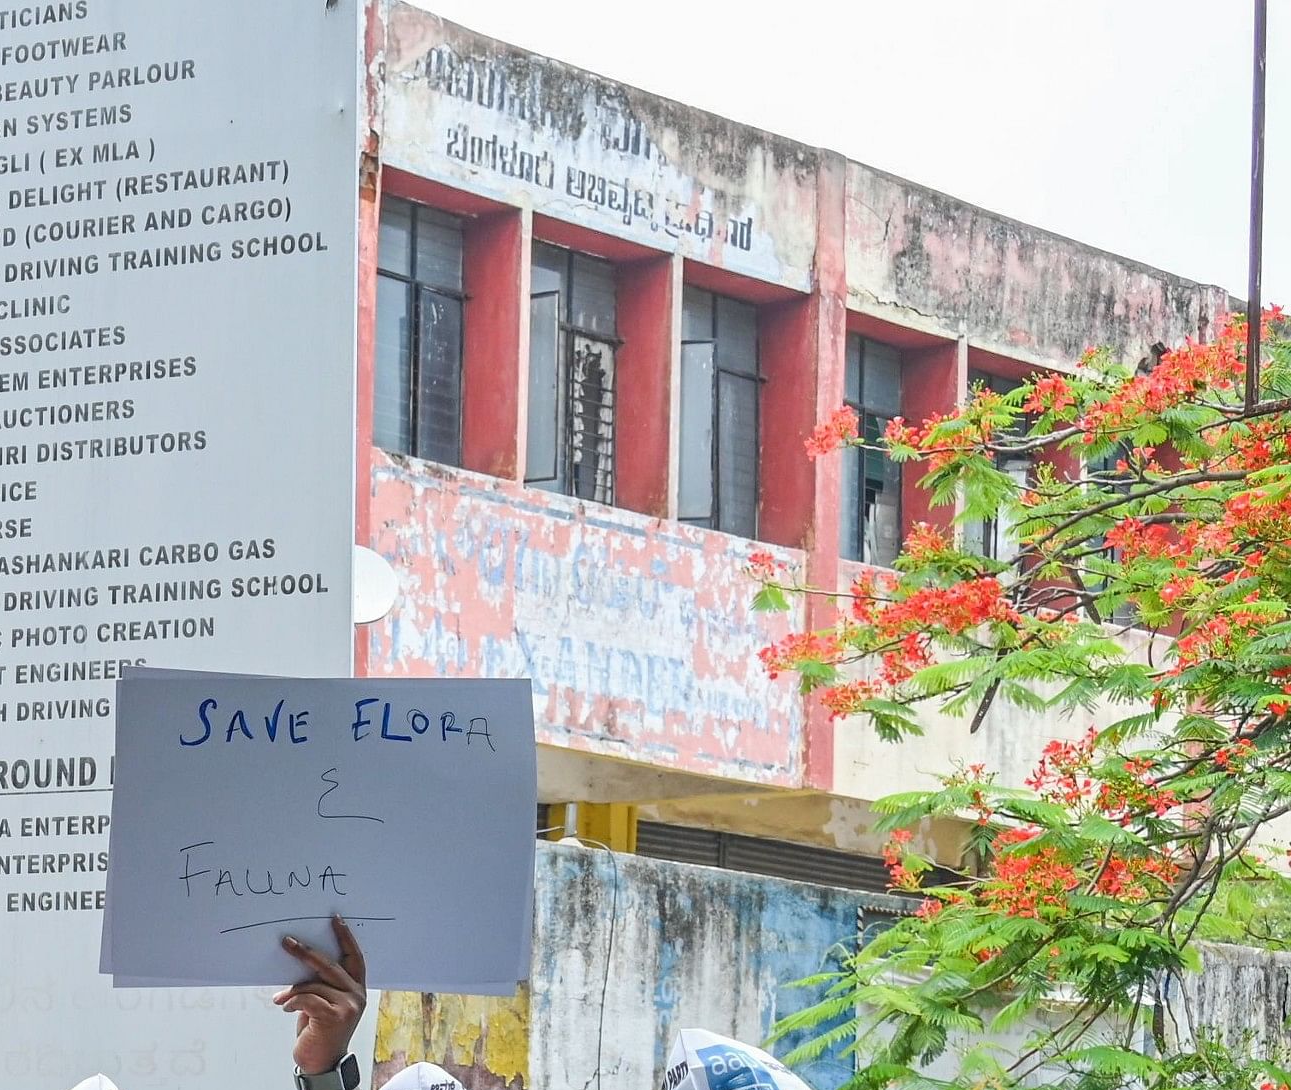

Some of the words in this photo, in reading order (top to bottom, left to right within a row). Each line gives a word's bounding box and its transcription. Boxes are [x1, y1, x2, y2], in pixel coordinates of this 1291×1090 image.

[2, 32, 126, 65] FOOTWEAR
[89, 60, 195, 91] PARLOUR
[27, 104, 131, 134] SYSTEMS
[9, 180, 106, 209] DELIGHT
[116, 160, 288, 202] (RESTAURANT)
[26, 215, 135, 249] (COURIER
[144, 208, 191, 231] AND
[202, 197, 291, 225] CARGO)
[5, 255, 98, 282] DRIVING
[108, 242, 221, 271] TRAINING
[232, 232, 327, 259] SCHOOL
[39, 356, 196, 389] ENTERPRISES
[37, 431, 206, 463] DISTRIBUTORS
[140, 542, 218, 566] CARBO
[229, 539, 275, 560] GAS
[4, 587, 98, 611] DRIVING
[108, 579, 221, 605] TRAINING
[231, 574, 328, 597] SCHOOL
[12, 625, 87, 647] PHOTO
[97, 617, 214, 642] CREATION
[17, 698, 109, 721] DRIVING
[179, 697, 309, 746] SAVE
[178, 840, 348, 898] FAUNA
